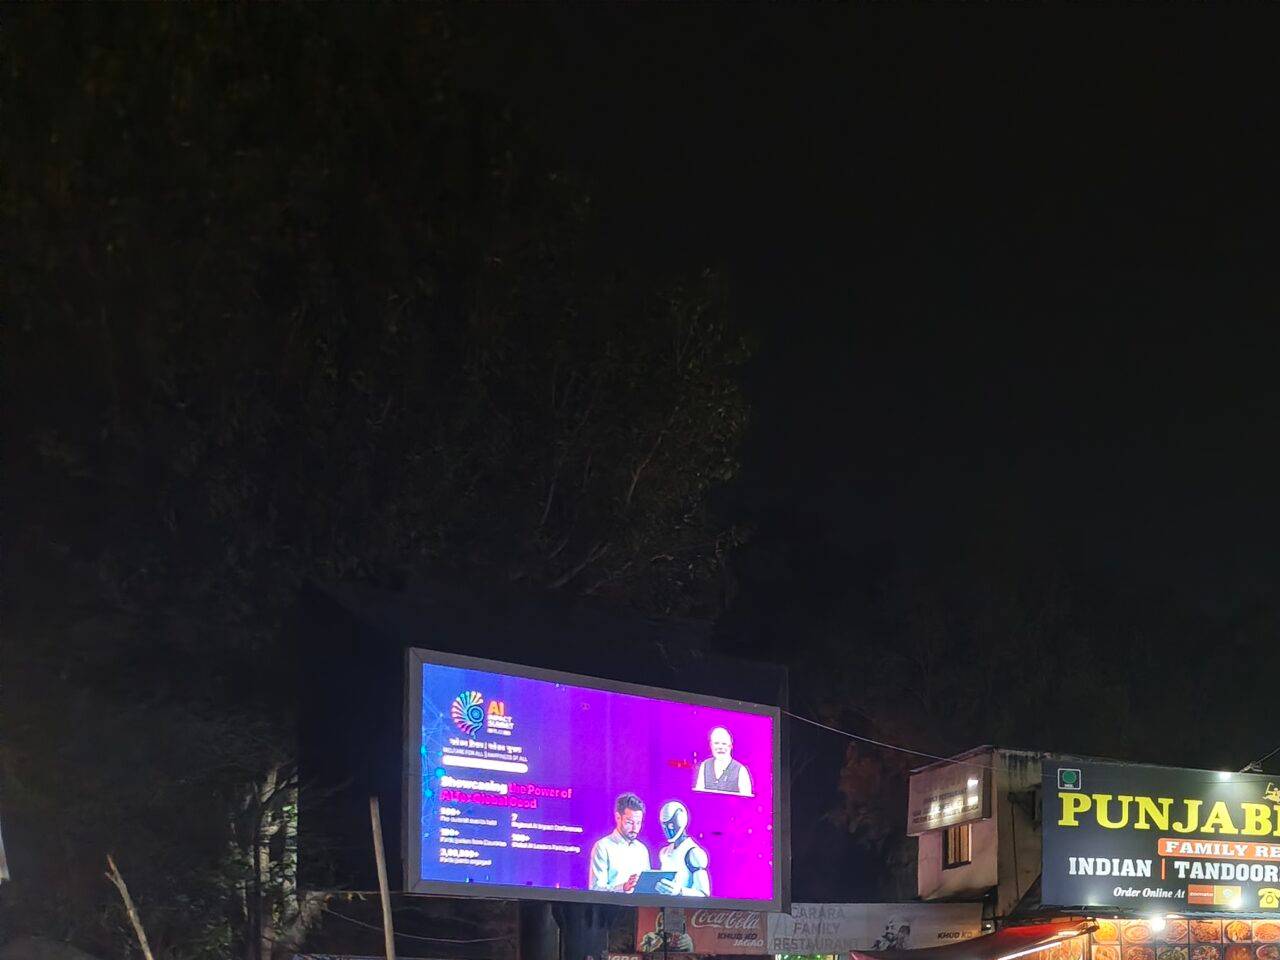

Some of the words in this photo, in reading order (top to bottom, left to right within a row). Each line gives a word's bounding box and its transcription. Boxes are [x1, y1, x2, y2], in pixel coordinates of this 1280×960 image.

[487, 700, 505, 717] AI
[441, 774, 508, 795] Showcasing
[509, 782, 527, 793] the
[527, 784, 559, 798] Power
[560, 788, 573, 799] of
[1165, 840, 1249, 858] FAMILY
[1069, 857, 1152, 878] INDIAN
[1113, 886, 1140, 898] Order
[1142, 886, 1173, 899] Online
[1174, 888, 1186, 899] At
